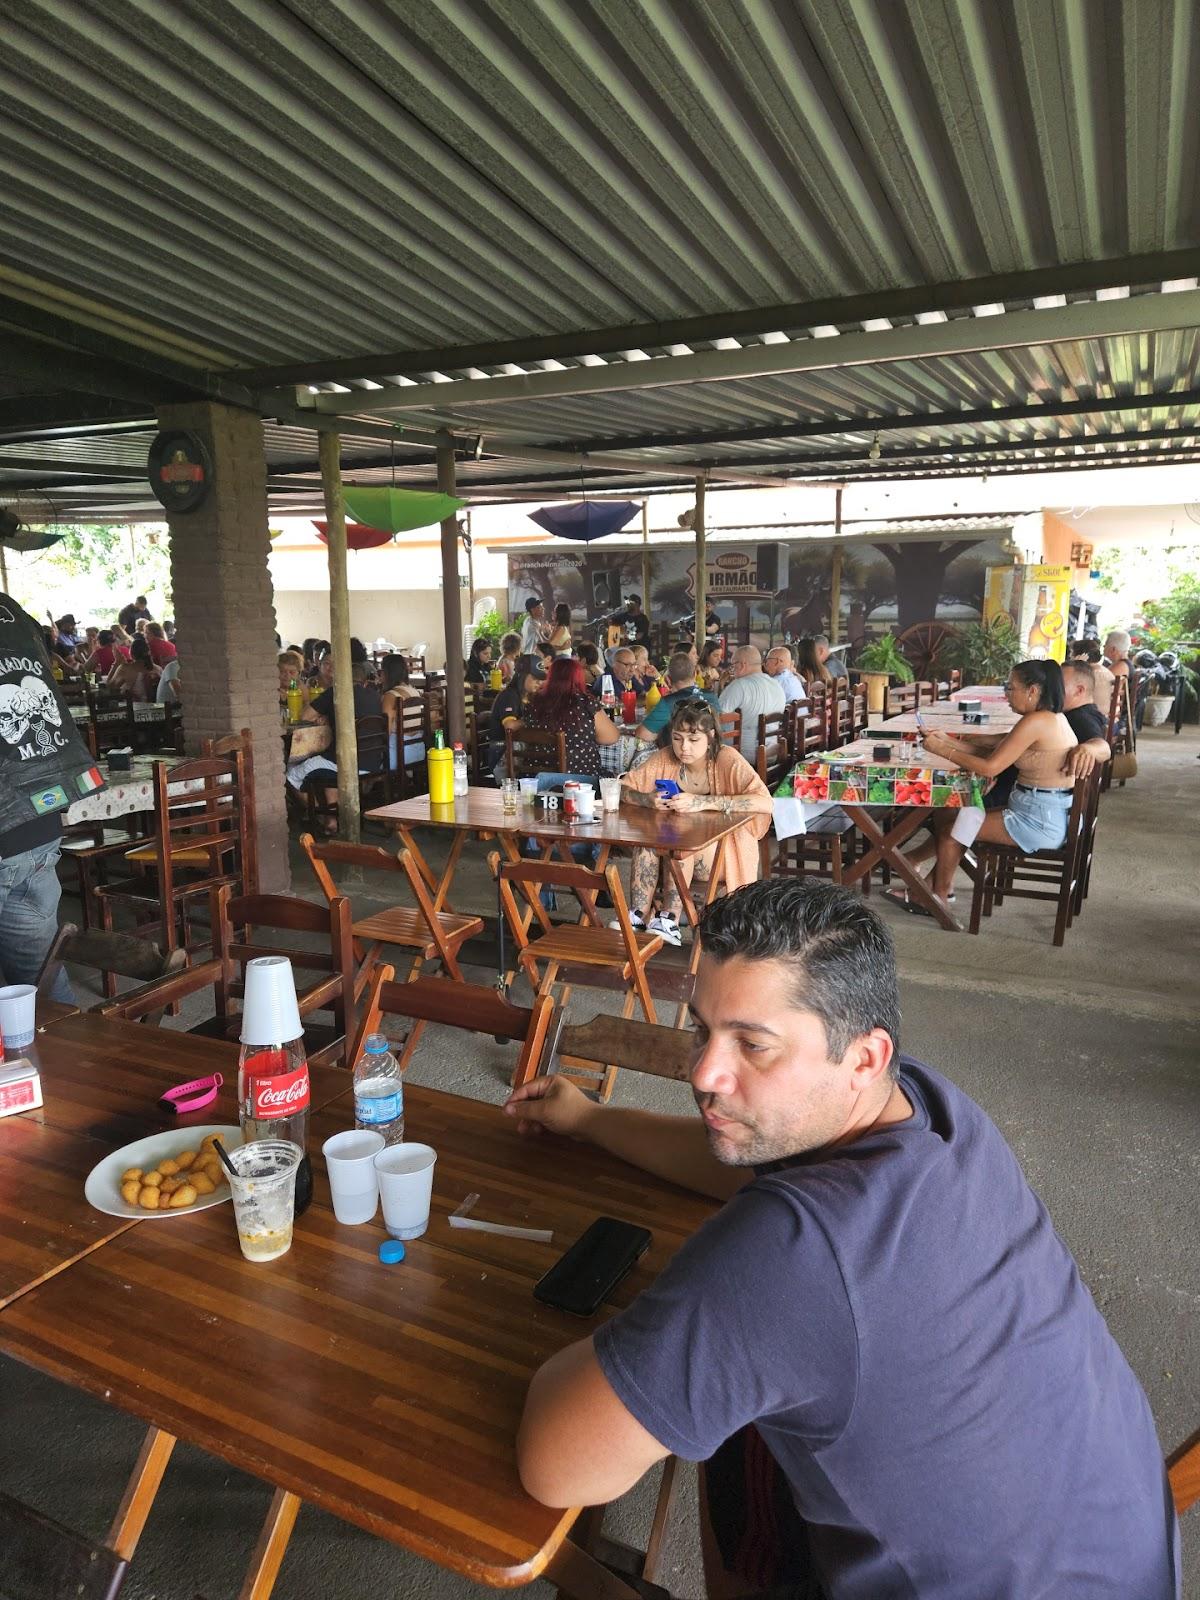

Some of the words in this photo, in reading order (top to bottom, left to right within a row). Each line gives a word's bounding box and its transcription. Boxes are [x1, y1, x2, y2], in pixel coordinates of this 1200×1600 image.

[18, 742, 41, 760] M.
[53, 731, 69, 747] C.
[541, 795, 558, 809] 18
[257, 1075, 309, 1108] Coca-Cola
